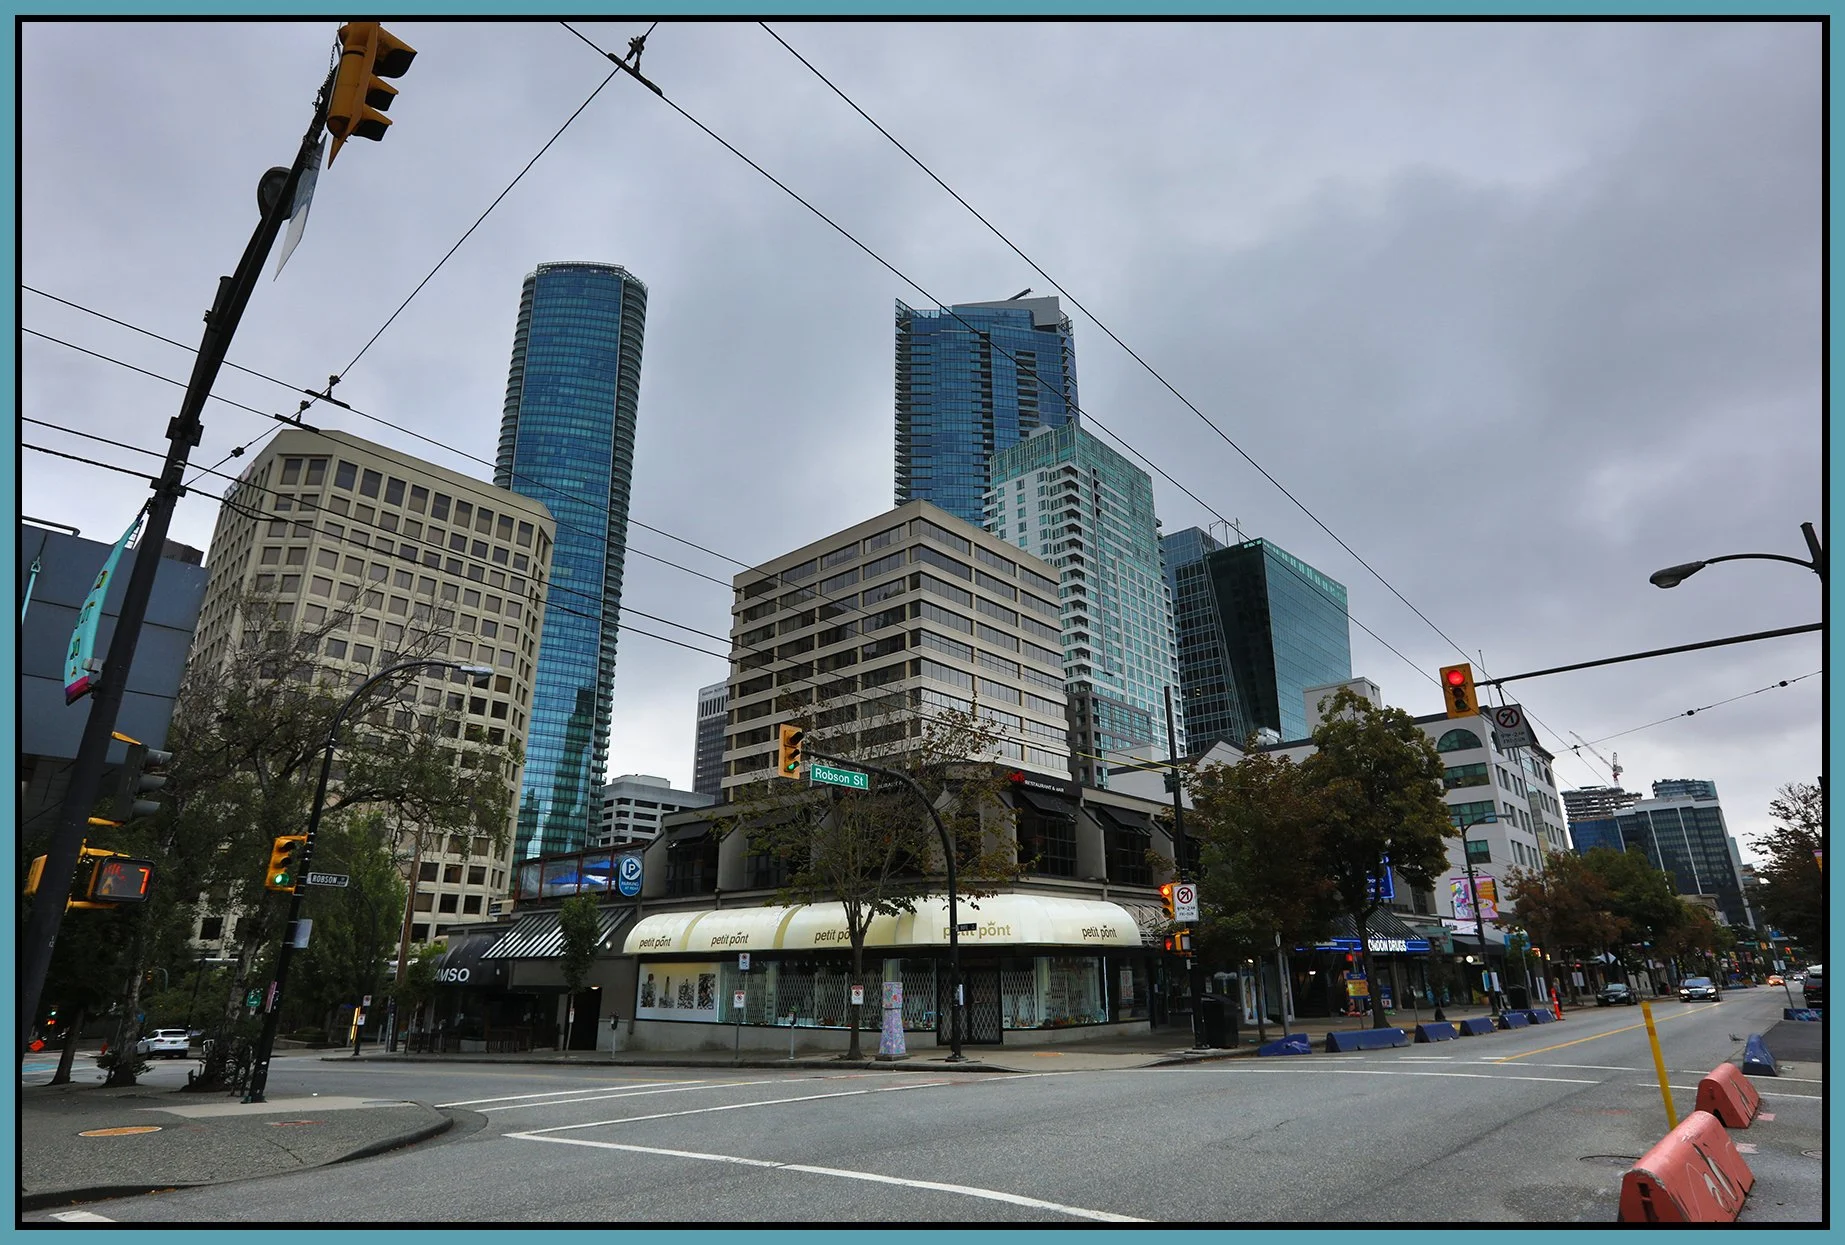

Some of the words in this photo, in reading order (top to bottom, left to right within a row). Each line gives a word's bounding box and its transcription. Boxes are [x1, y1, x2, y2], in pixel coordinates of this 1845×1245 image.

[815, 767, 850, 784] Robson
[853, 775, 864, 786] St
[628, 863, 636, 874] P
[138, 867, 151, 895] 7
[312, 874, 338, 884] ROBSON
[814, 930, 836, 943] petit
[1081, 926, 1100, 940] petit
[639, 938, 655, 949] petit
[711, 935, 730, 947] petit
[1367, 940, 1388, 952] ONDON
[1388, 940, 1407, 952] DRUGS
